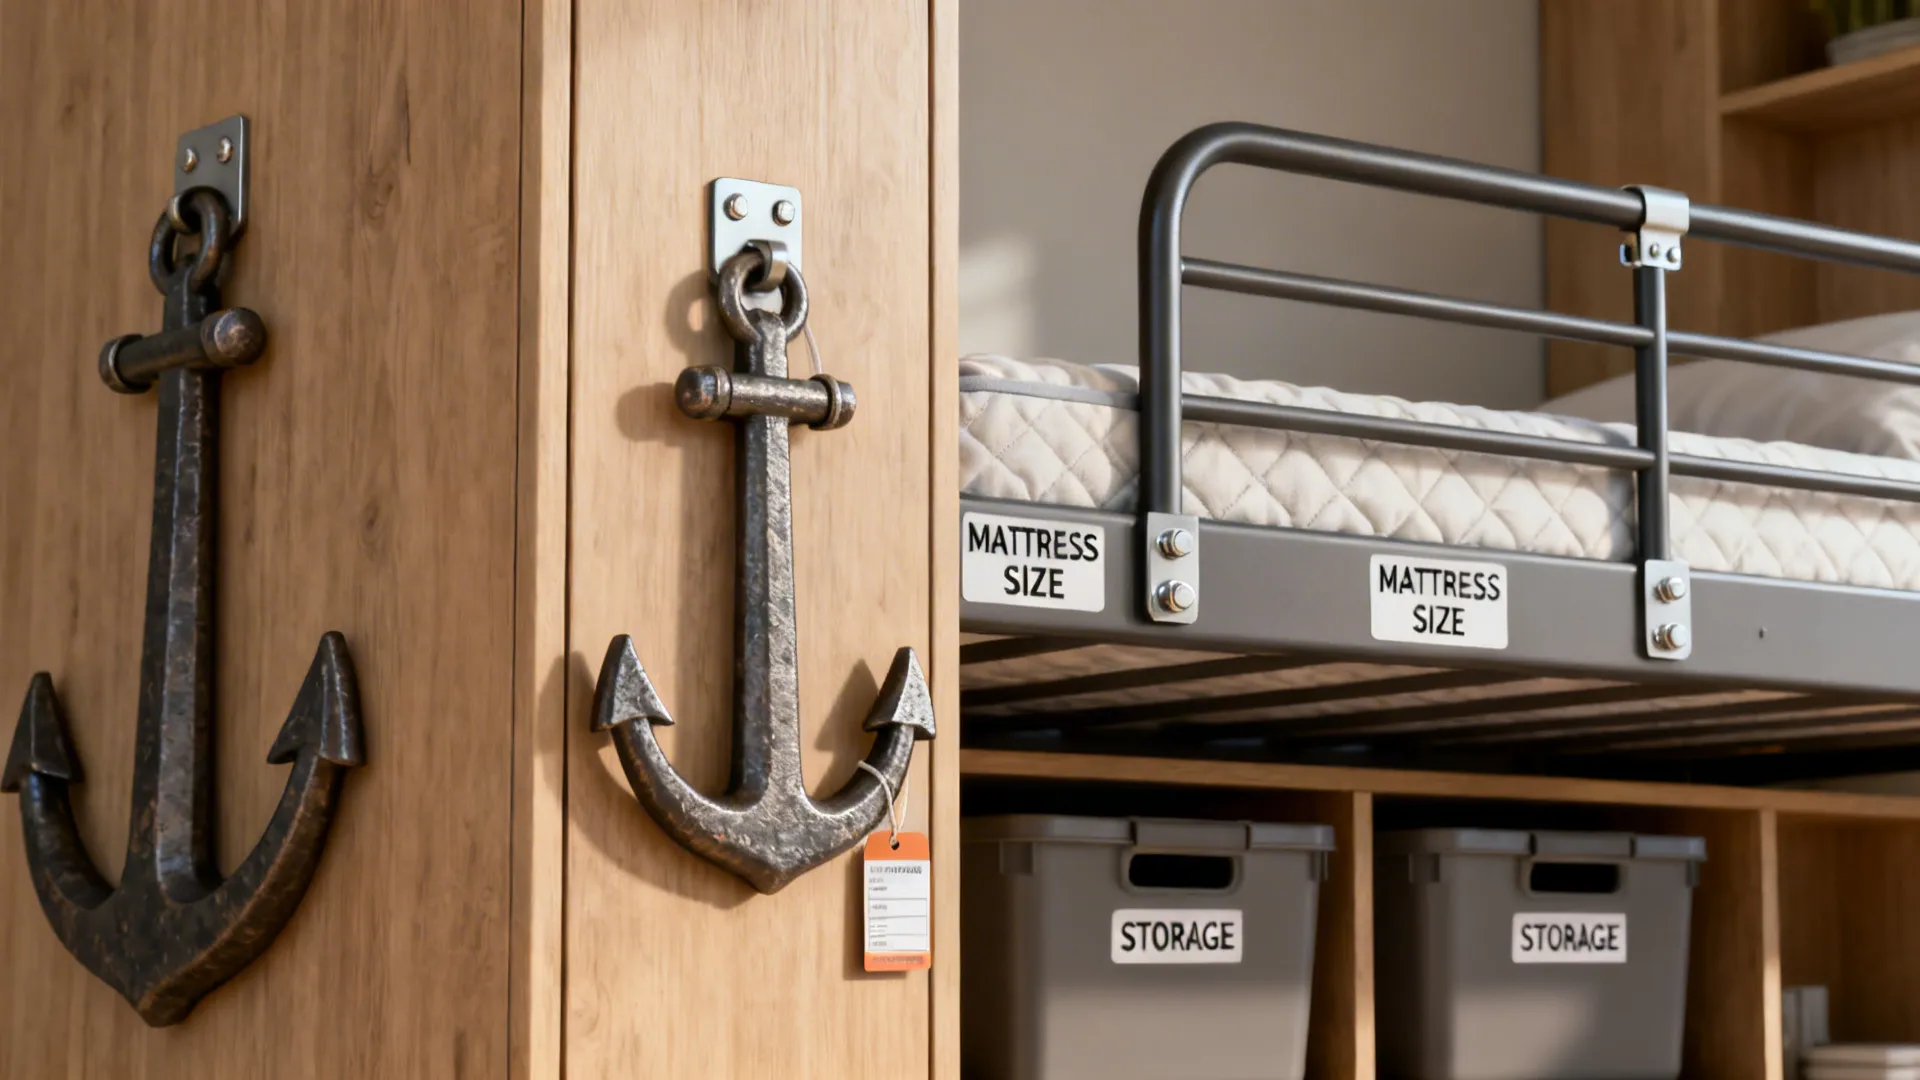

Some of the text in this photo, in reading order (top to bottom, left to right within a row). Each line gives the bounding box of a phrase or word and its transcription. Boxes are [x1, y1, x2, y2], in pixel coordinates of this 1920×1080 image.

[968, 521, 1099, 562] MATTRESS
[1003, 564, 1065, 600] SIZE
[1379, 564, 1501, 601] MATTRESS
[1412, 604, 1465, 636] SIZE
[1121, 921, 1235, 952] STORAGE
[1520, 923, 1619, 952] STORAGE
